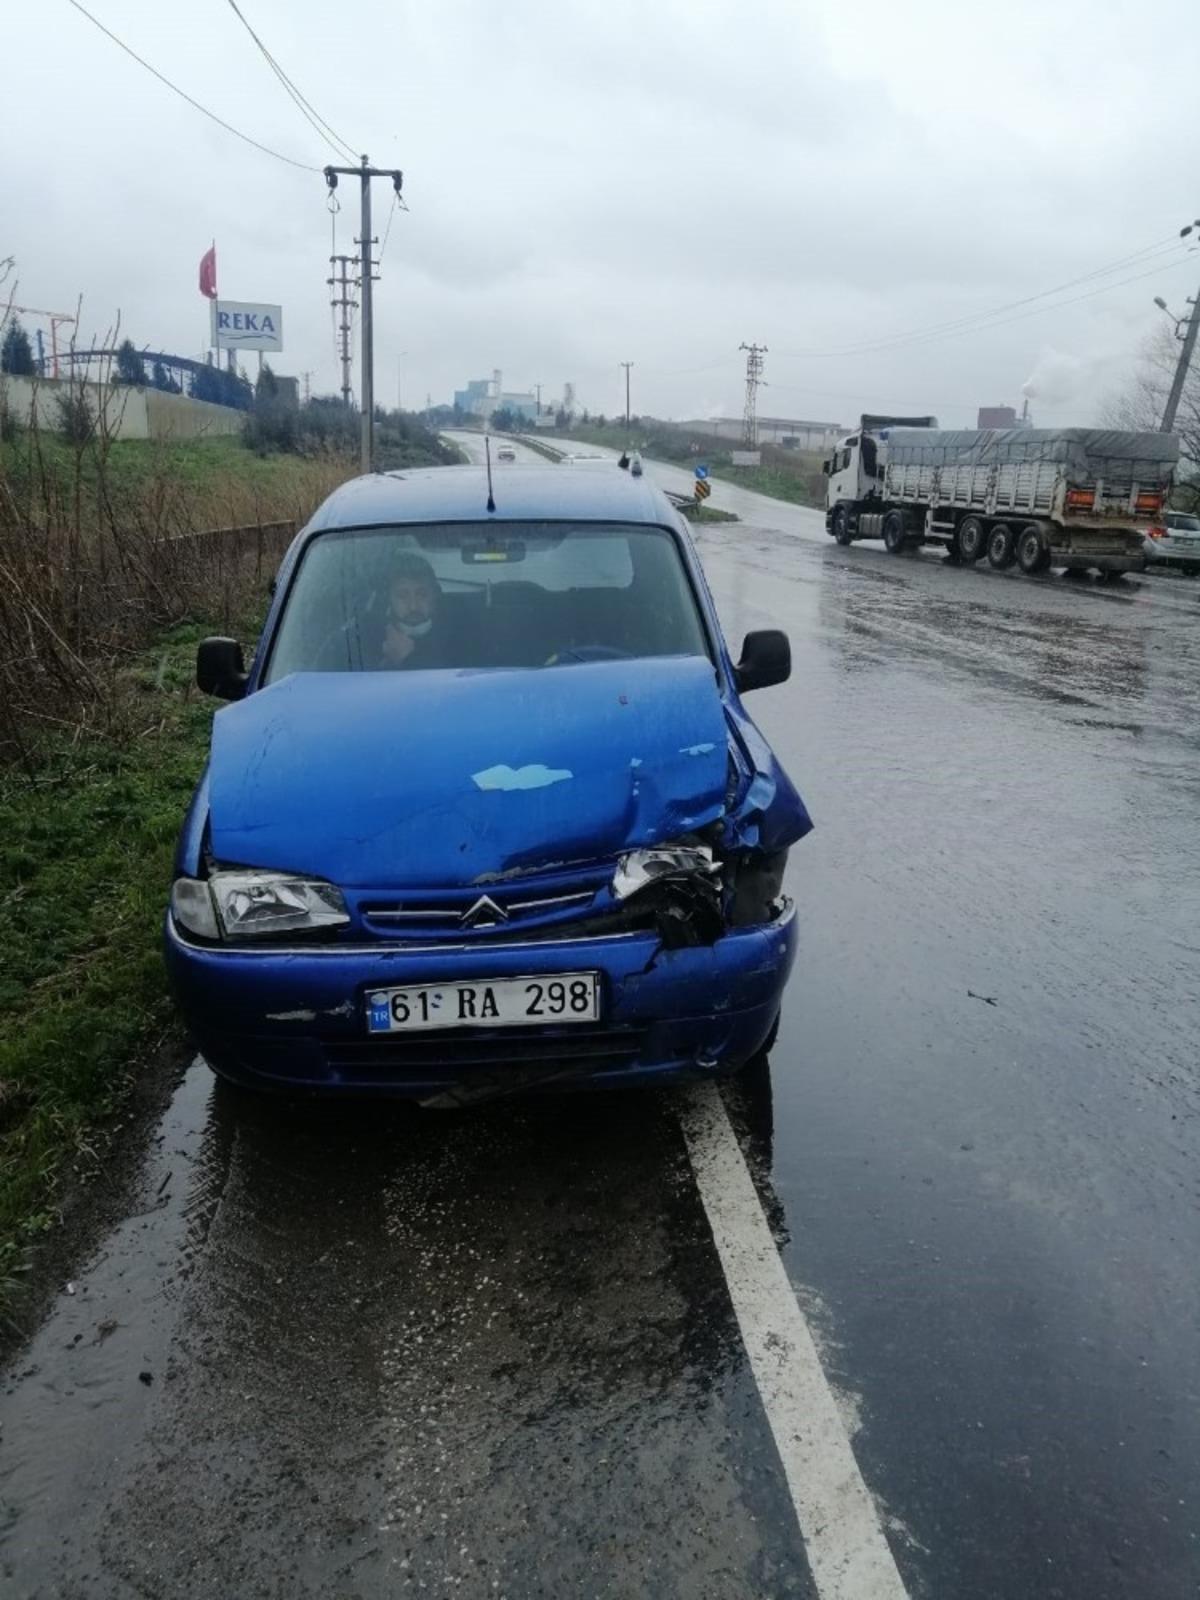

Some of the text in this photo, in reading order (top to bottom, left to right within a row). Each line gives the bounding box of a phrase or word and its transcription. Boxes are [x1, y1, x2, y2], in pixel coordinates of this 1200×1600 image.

[218, 311, 275, 332] REKA
[391, 981, 589, 1022] 61 RA 298
[374, 1011, 389, 1022] TR
